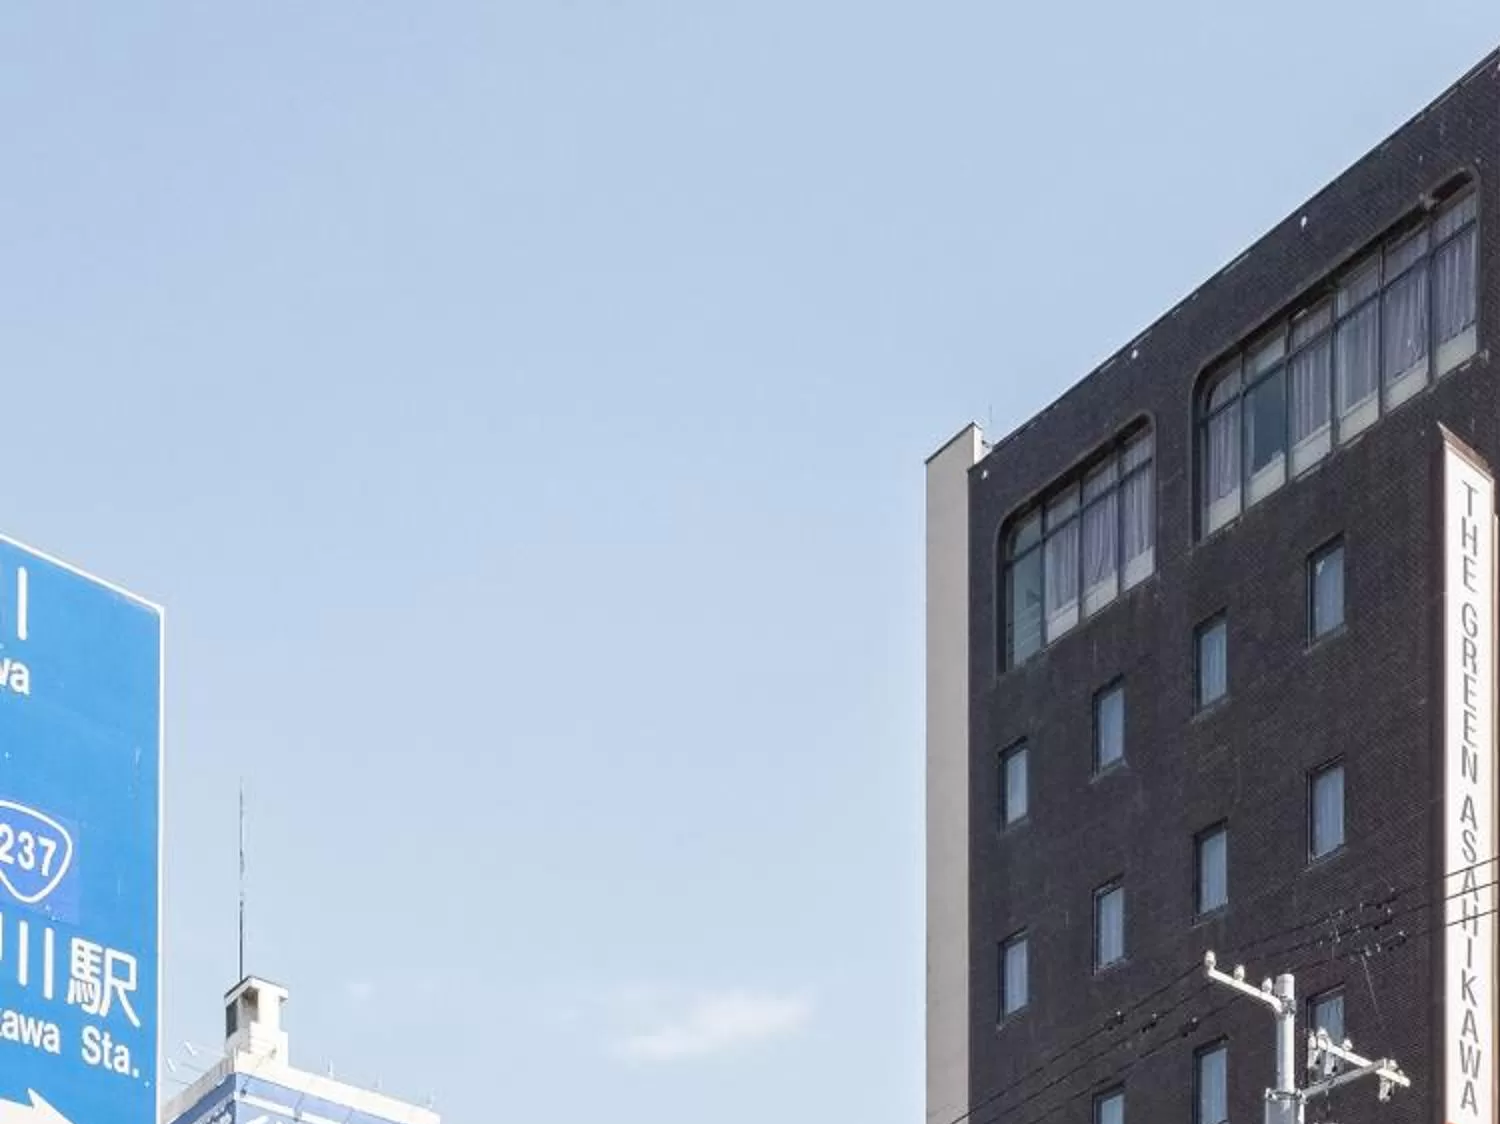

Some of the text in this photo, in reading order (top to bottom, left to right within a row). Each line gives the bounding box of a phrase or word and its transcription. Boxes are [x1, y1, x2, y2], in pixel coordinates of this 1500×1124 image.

[1459, 480, 1481, 1117] THE GREEN ASAHIKAWA
[0, 823, 57, 877] 237
[0, 1008, 140, 1078] awa Sta.
